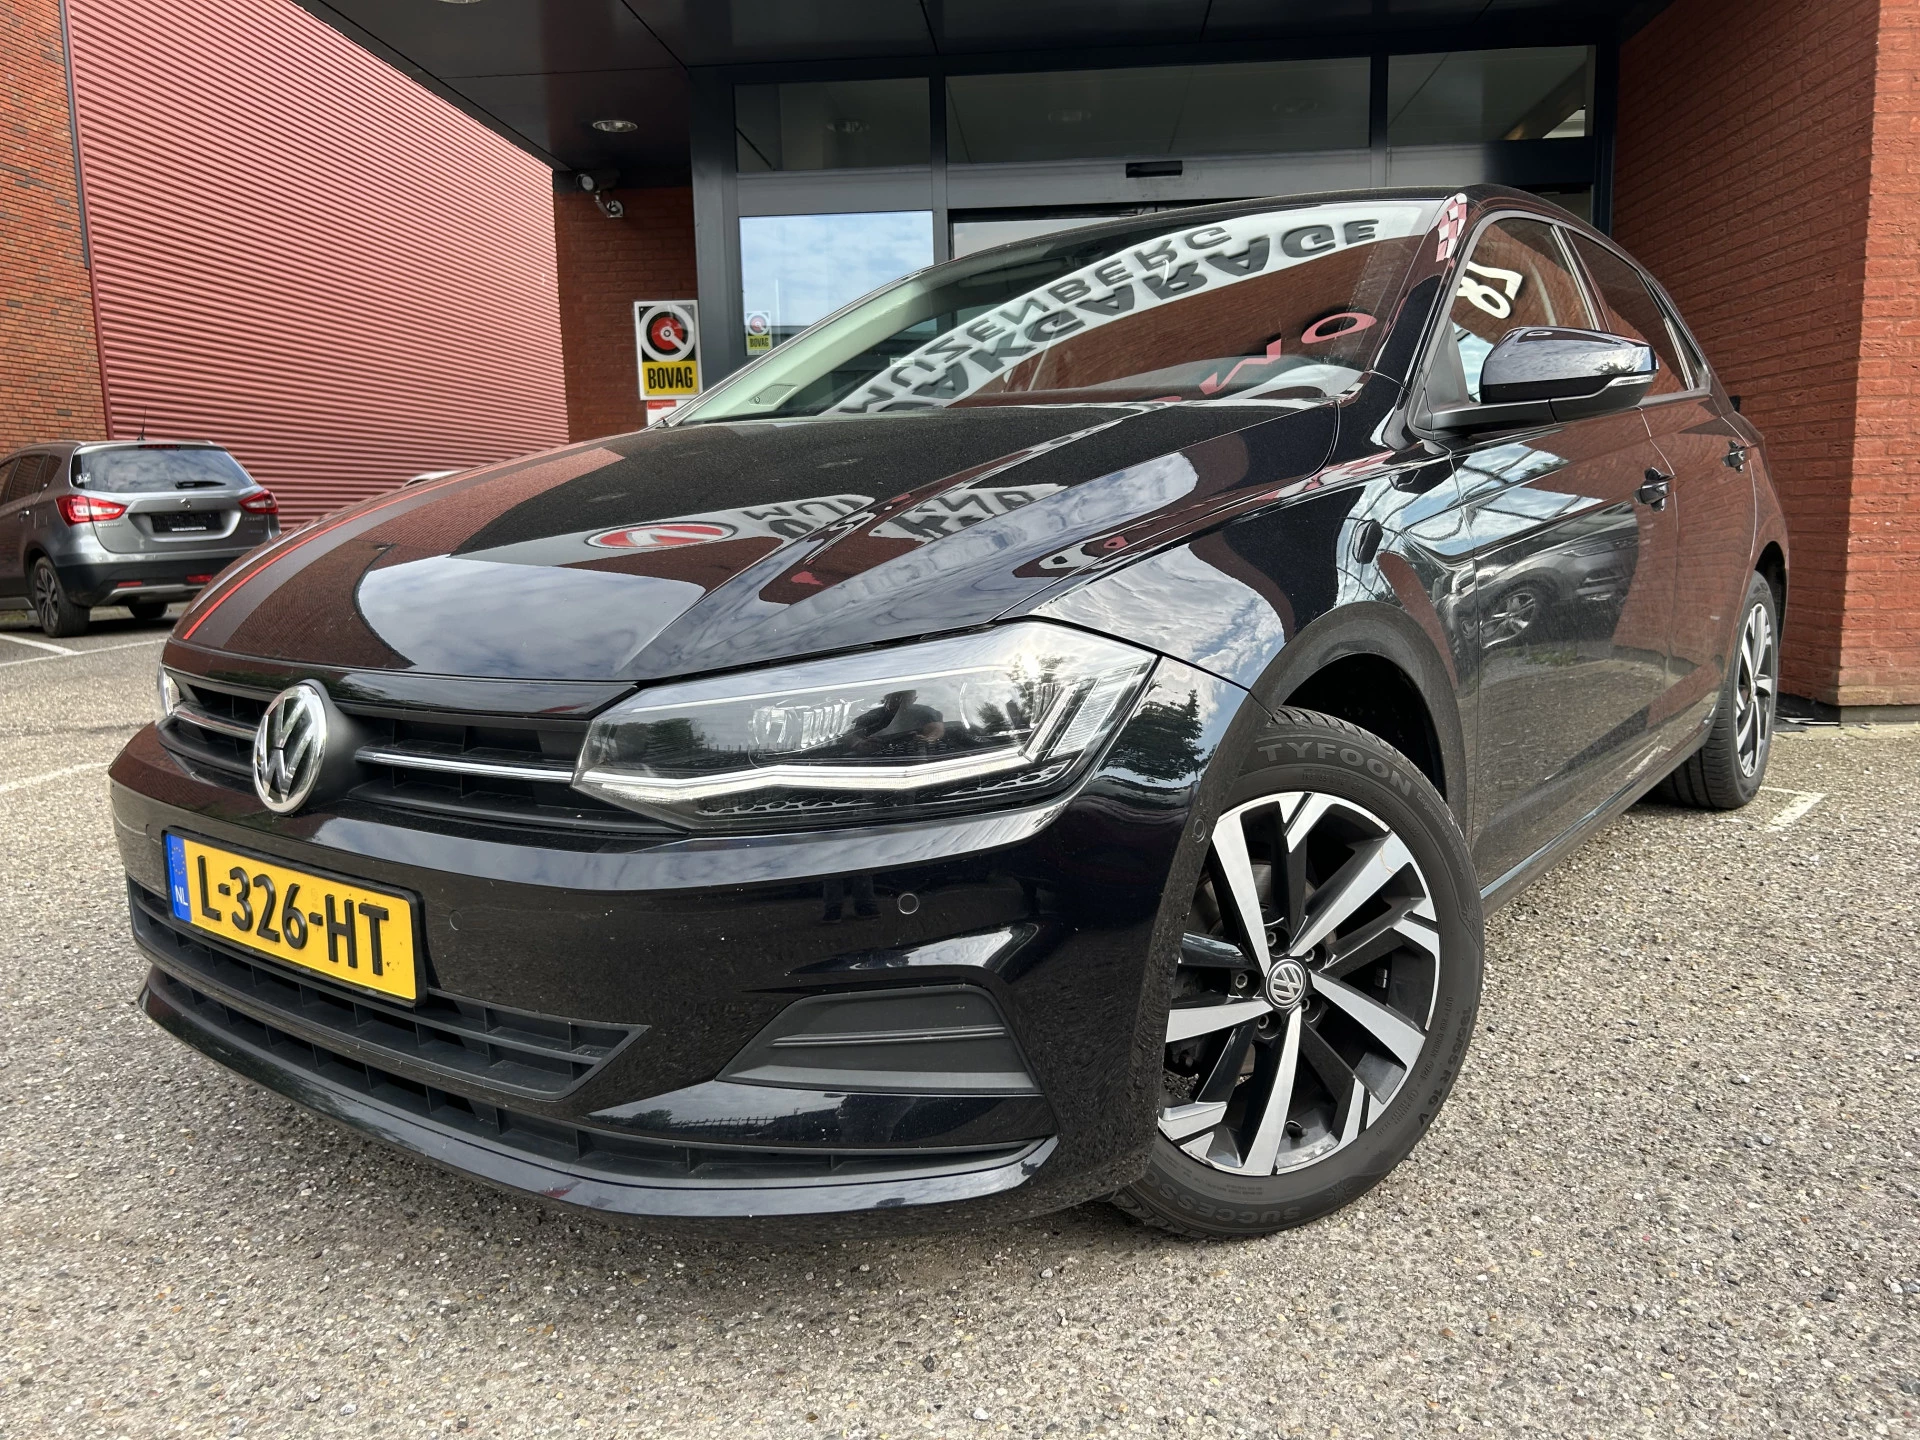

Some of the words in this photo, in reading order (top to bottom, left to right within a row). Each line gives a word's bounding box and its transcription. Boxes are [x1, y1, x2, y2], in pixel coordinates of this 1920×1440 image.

[750, 337, 770, 349] BOVAG
[647, 366, 694, 389] BOVAG
[1257, 741, 1412, 796] TYFOON
[174, 885, 189, 907] NL
[197, 855, 389, 976] L-326-HT
